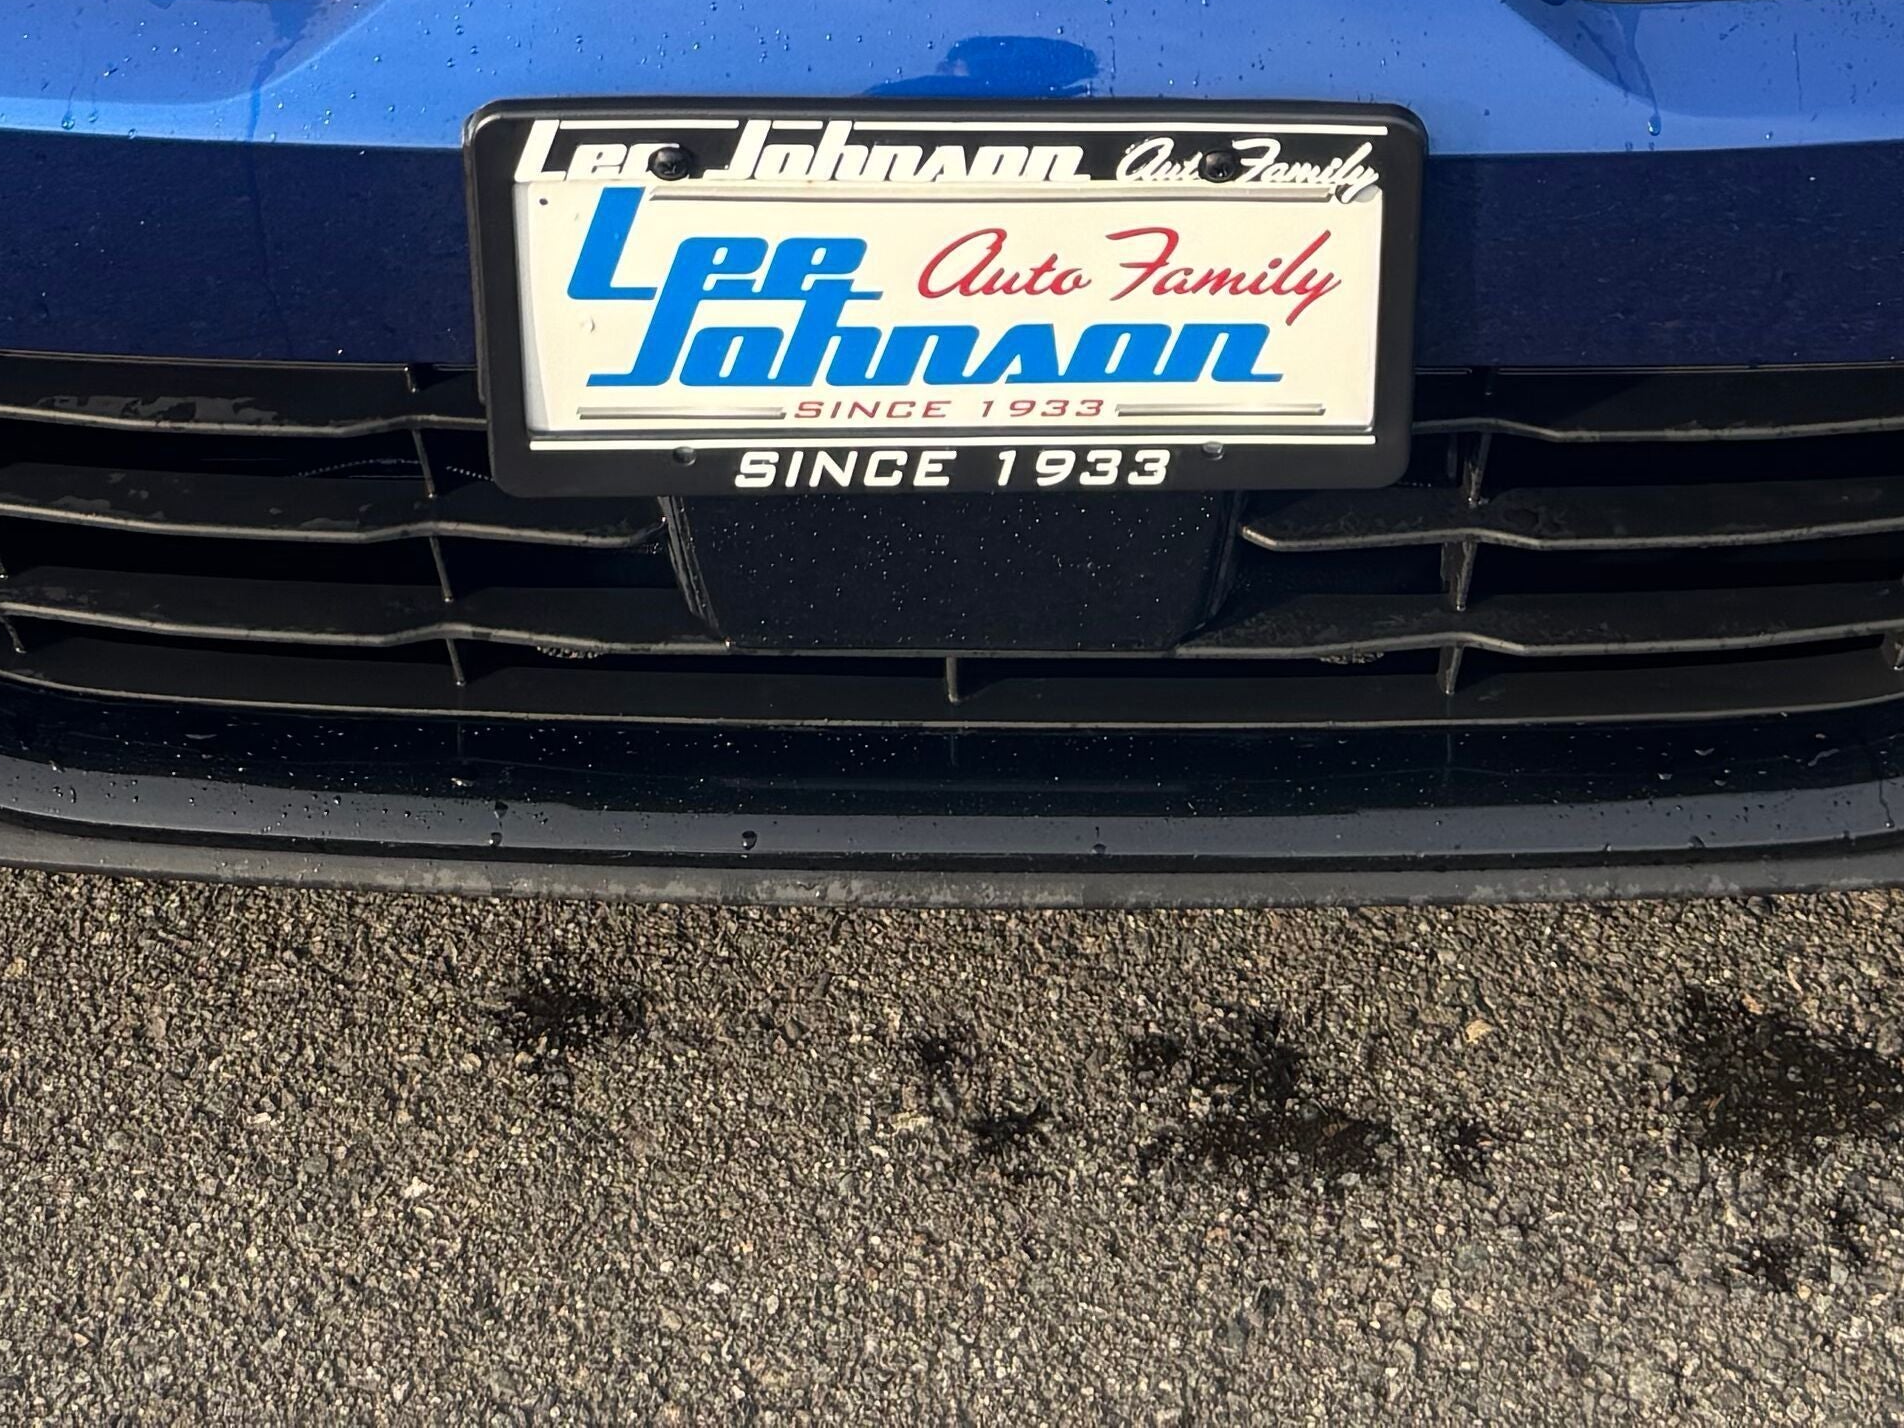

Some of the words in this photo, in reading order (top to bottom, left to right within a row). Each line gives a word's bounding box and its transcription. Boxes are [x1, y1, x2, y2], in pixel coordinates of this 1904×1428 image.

[702, 119, 1092, 182] Johnson
[1116, 137, 1232, 183] Aut
[1232, 138, 1380, 204] Family
[567, 187, 883, 301] Lee
[918, 227, 1094, 301] Auto
[1106, 227, 1345, 326] Family
[586, 291, 1284, 387] Johnson
[793, 400, 953, 420] SINCE
[980, 399, 1106, 419] 1933
[734, 450, 959, 488] SINCE
[997, 449, 1172, 487] 1933
